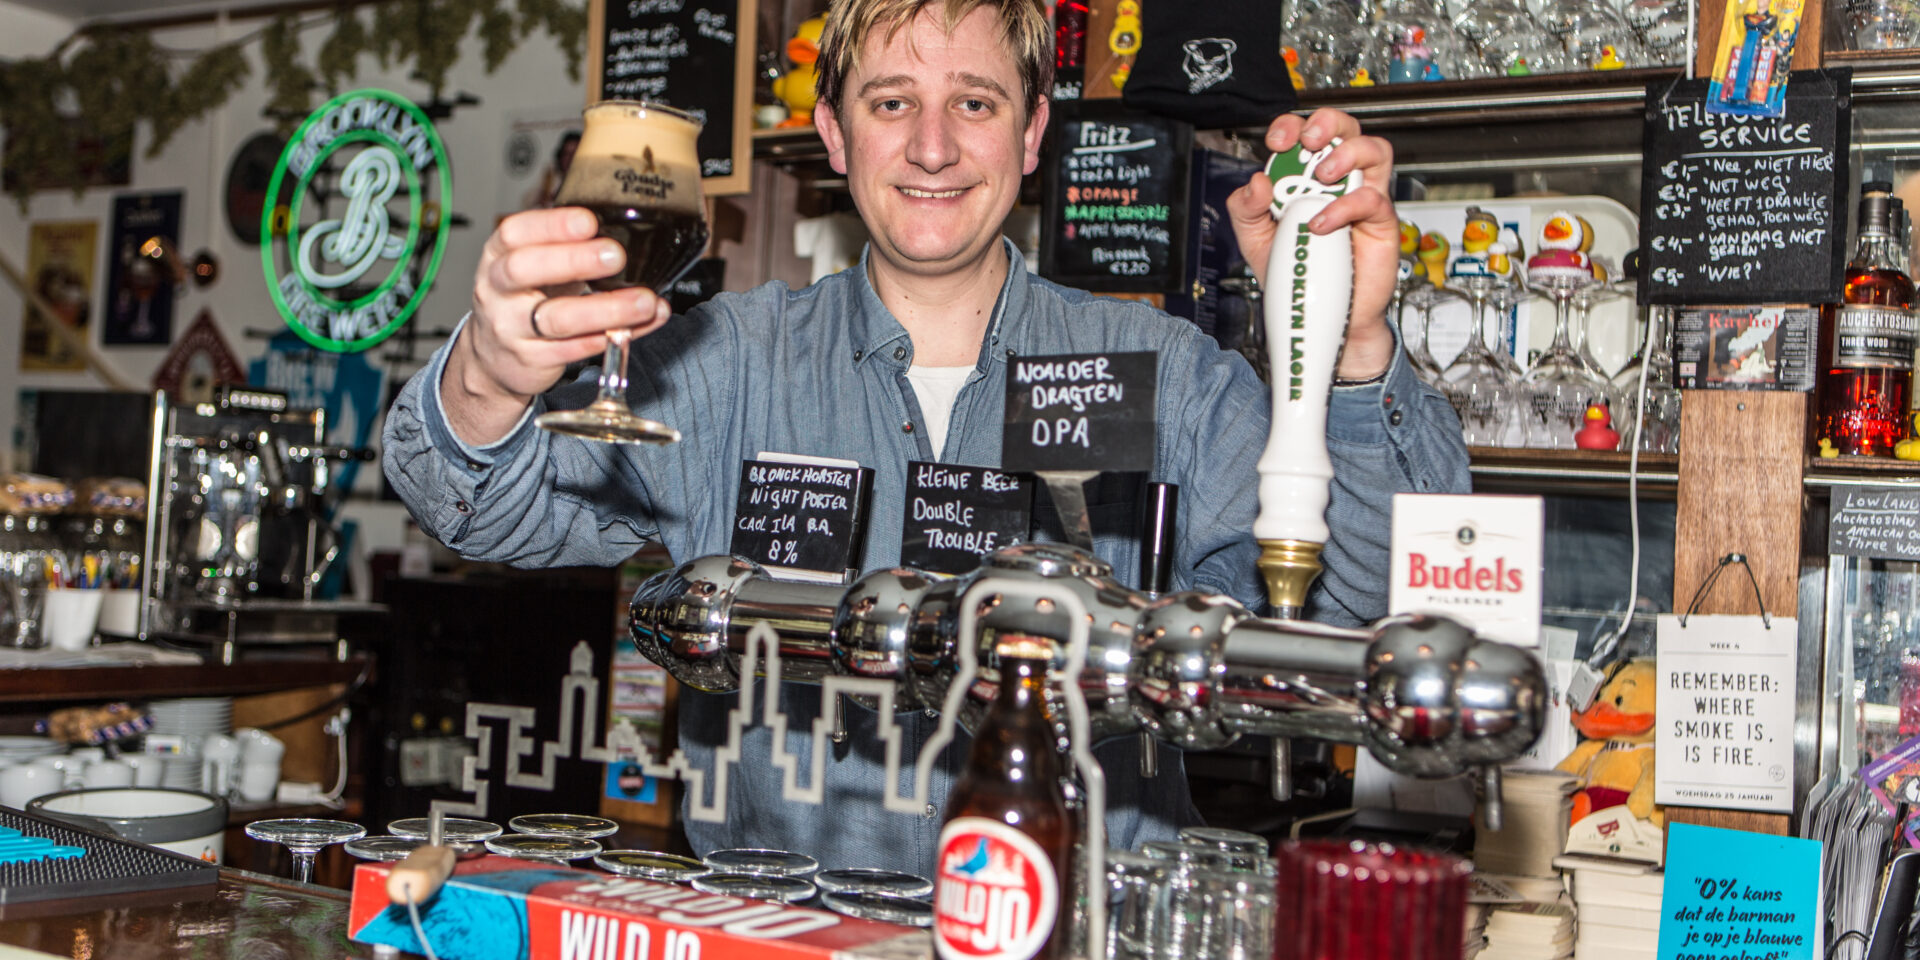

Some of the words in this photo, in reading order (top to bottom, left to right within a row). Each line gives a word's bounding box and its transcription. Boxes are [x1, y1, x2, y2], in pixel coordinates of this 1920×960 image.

[287, 97, 435, 177] BROOKLYN
[1080, 121, 1131, 147] Fritz
[1700, 119, 1811, 149] SERVICE
[1290, 222, 1312, 329] BROOKLYN
[278, 271, 414, 342] BREWERY
[1866, 337, 1889, 349] WOOD
[1017, 357, 1114, 383] NOARDER
[1032, 383, 1123, 412] DRAGTEN
[1032, 416, 1090, 448] DPA
[801, 490, 848, 510] PORTER
[924, 528, 998, 555] TROUBLE
[1408, 552, 1524, 593] Budels
[1427, 595, 1503, 606] PILSENER
[1670, 671, 1780, 694] REMEMBER:
[1694, 696, 1755, 717] WHERE
[1674, 720, 1734, 741] SMOKE
[1685, 745, 1701, 764] IS
[1713, 746, 1762, 767] FIRE.
[1675, 789, 1722, 799] WOENSDAG
[1737, 793, 1774, 802] JANUARI
[1743, 885, 1783, 902] kans
[1674, 905, 1703, 923] dat
[1705, 906, 1724, 923] de
[1727, 905, 1796, 924] barman
[560, 909, 651, 960] WILD
[1681, 925, 1700, 948] je
[1703, 932, 1723, 948] op
[1721, 926, 1741, 949] je
[1743, 927, 1803, 947] blauwe
